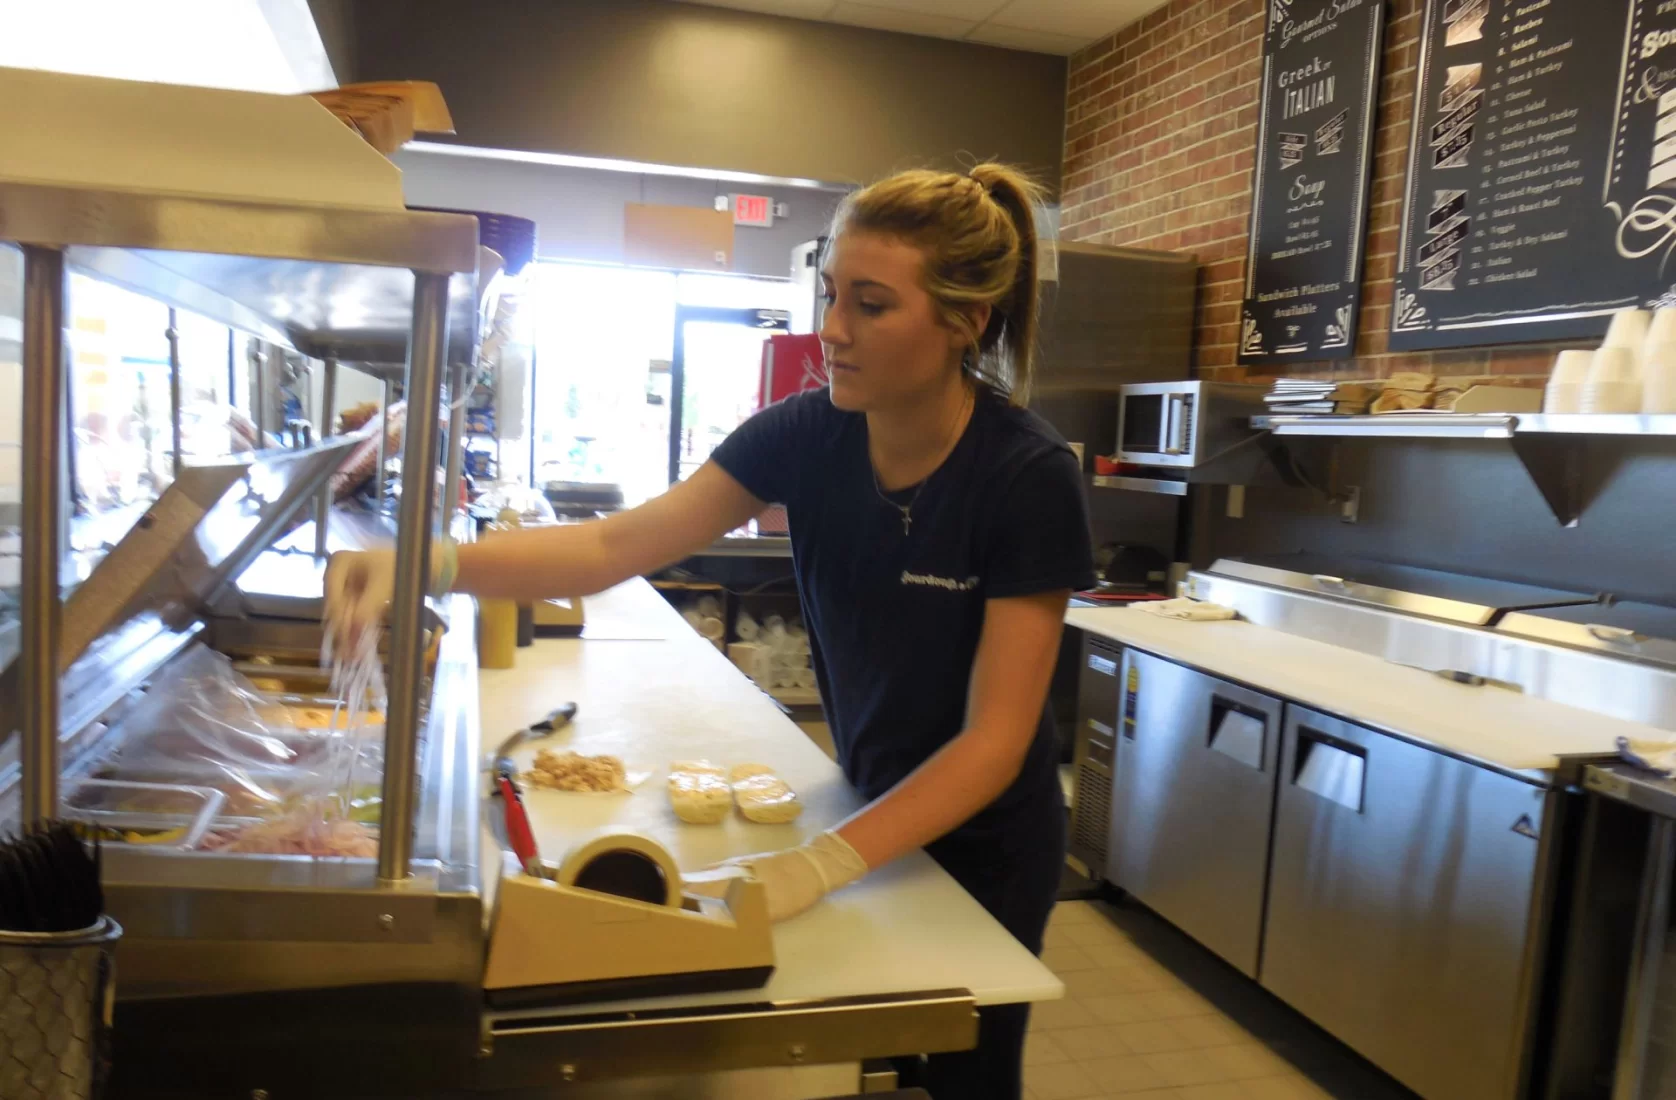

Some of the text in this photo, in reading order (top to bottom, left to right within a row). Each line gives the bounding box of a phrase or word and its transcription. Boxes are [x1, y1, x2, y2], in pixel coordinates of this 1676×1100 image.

[1280, 8, 1326, 49] Gourmet
[1509, 57, 1528, 69] Ham
[1536, 38, 1573, 58] Pastrami
[1511, 33, 1538, 52] Salami
[1278, 56, 1322, 88] Greek
[1508, 74, 1526, 86] Ham
[1534, 61, 1563, 77] Turkey
[1283, 75, 1335, 120] ITALIAN
[1503, 107, 1524, 119] Tuna
[1524, 97, 1547, 113] Salad
[1437, 101, 1478, 134] Regular
[1549, 107, 1579, 122] Turkey
[1500, 140, 1528, 152] Turkey
[1536, 123, 1577, 142] Pepperoni
[1498, 152, 1533, 169] Pastrami
[1541, 144, 1571, 158] Turkey
[1496, 170, 1524, 185] Corned
[1524, 166, 1542, 178] Beef
[1550, 159, 1580, 171] Turkey
[1288, 174, 1326, 201] Soup
[1525, 182, 1553, 196] Pepper
[1553, 175, 1585, 189] Turkey
[736, 195, 768, 222] EXIT
[1541, 195, 1562, 209] Beef
[1429, 230, 1460, 253] Large
[1488, 240, 1516, 251] Turkey
[1540, 228, 1569, 242] Salami
[1484, 272, 1516, 284] Chicken
[1515, 267, 1538, 279] Salad
[1257, 282, 1341, 302] Sandwich Platters
[1273, 303, 1318, 319] Available
